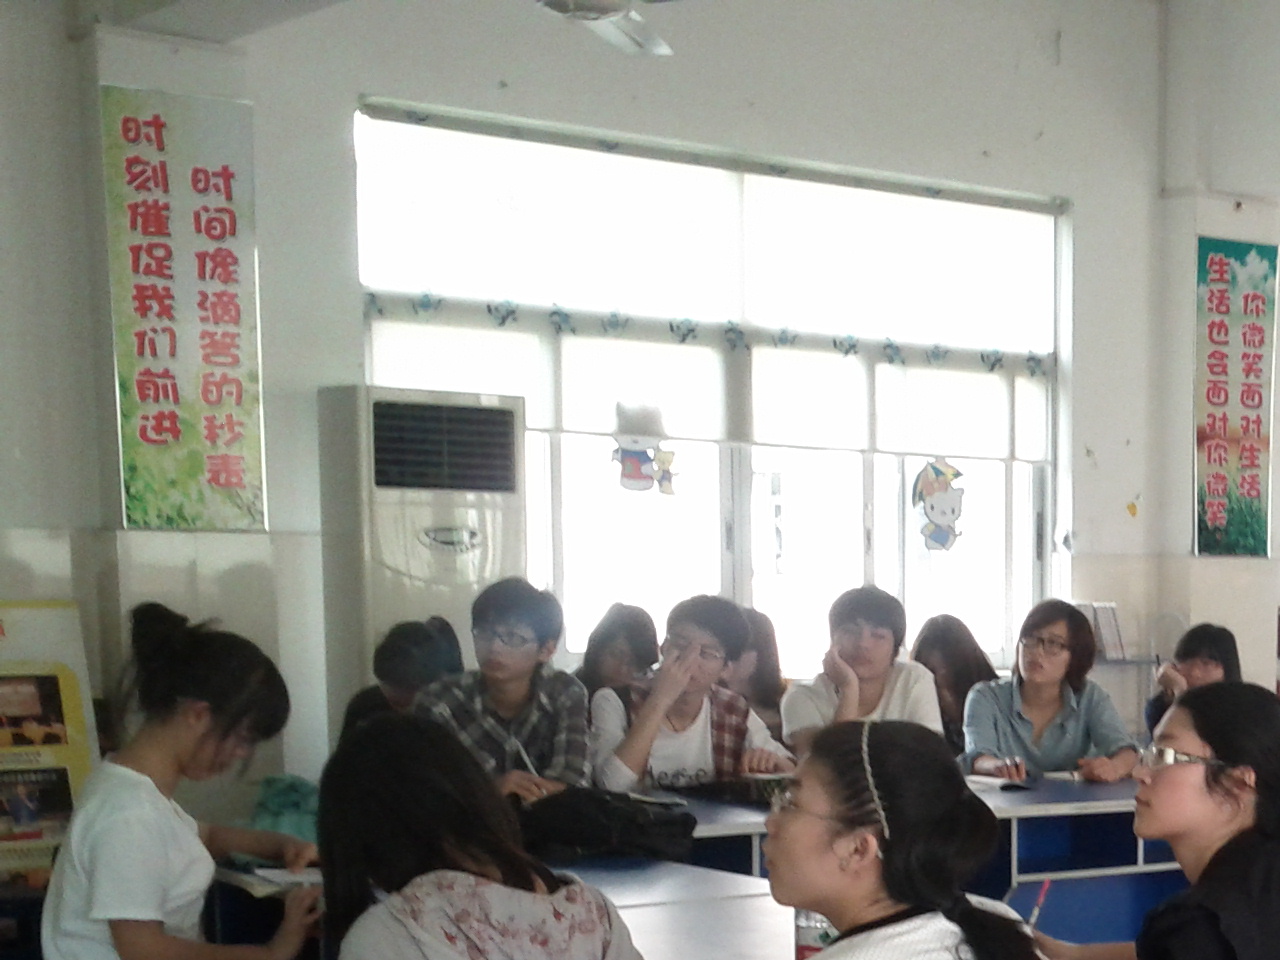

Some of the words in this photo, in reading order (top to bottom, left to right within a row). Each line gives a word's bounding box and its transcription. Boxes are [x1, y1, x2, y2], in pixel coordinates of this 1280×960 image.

[120, 113, 182, 446] 时刻催促我们前进
[191, 164, 247, 490] 时间像滴答的秒表
[1205, 252, 1231, 528] 生活也会面对你微笑
[1238, 290, 1267, 499] 你微笑面对生活
